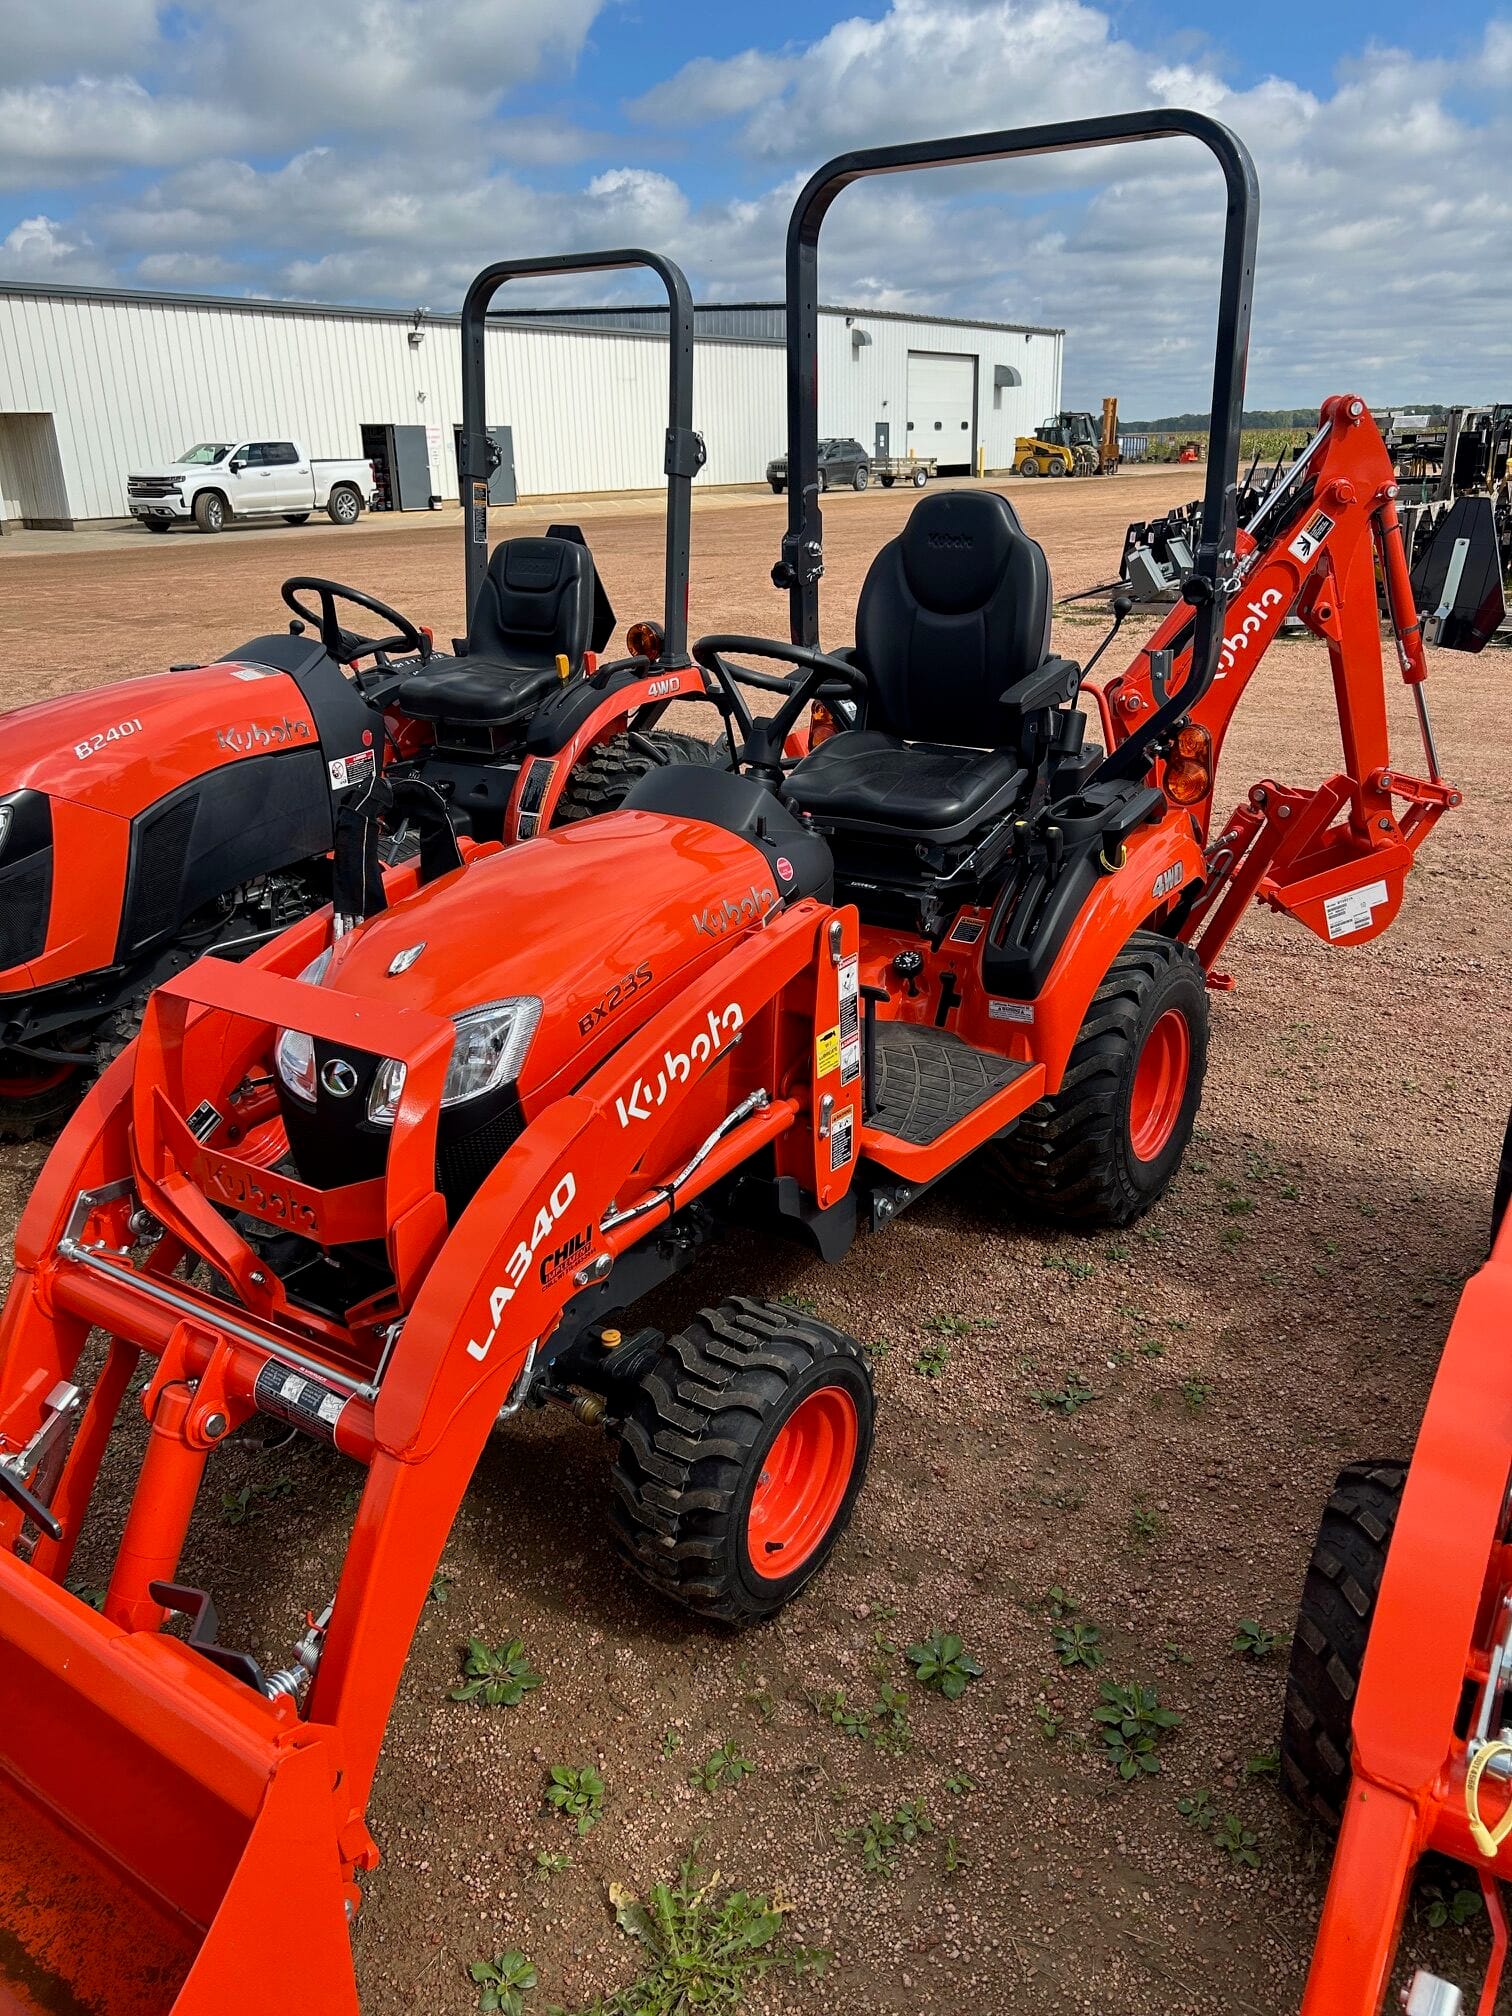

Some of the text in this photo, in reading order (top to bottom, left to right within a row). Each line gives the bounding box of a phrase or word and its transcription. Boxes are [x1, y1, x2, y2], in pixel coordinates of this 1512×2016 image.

[648, 677, 681, 697] 4WD
[74, 719, 143, 760] B2401
[217, 716, 310, 752] Kubota
[1152, 860, 1183, 898] 4WD
[691, 886, 775, 937] Kubota
[577, 961, 653, 1037] BX23S
[615, 1002, 744, 1129] Kubota
[205, 1158, 318, 1231] Kubota
[466, 1172, 576, 1361] LA340
[540, 1223, 593, 1285] CHILI
[546, 1243, 592, 1283] IMPLEMENT
